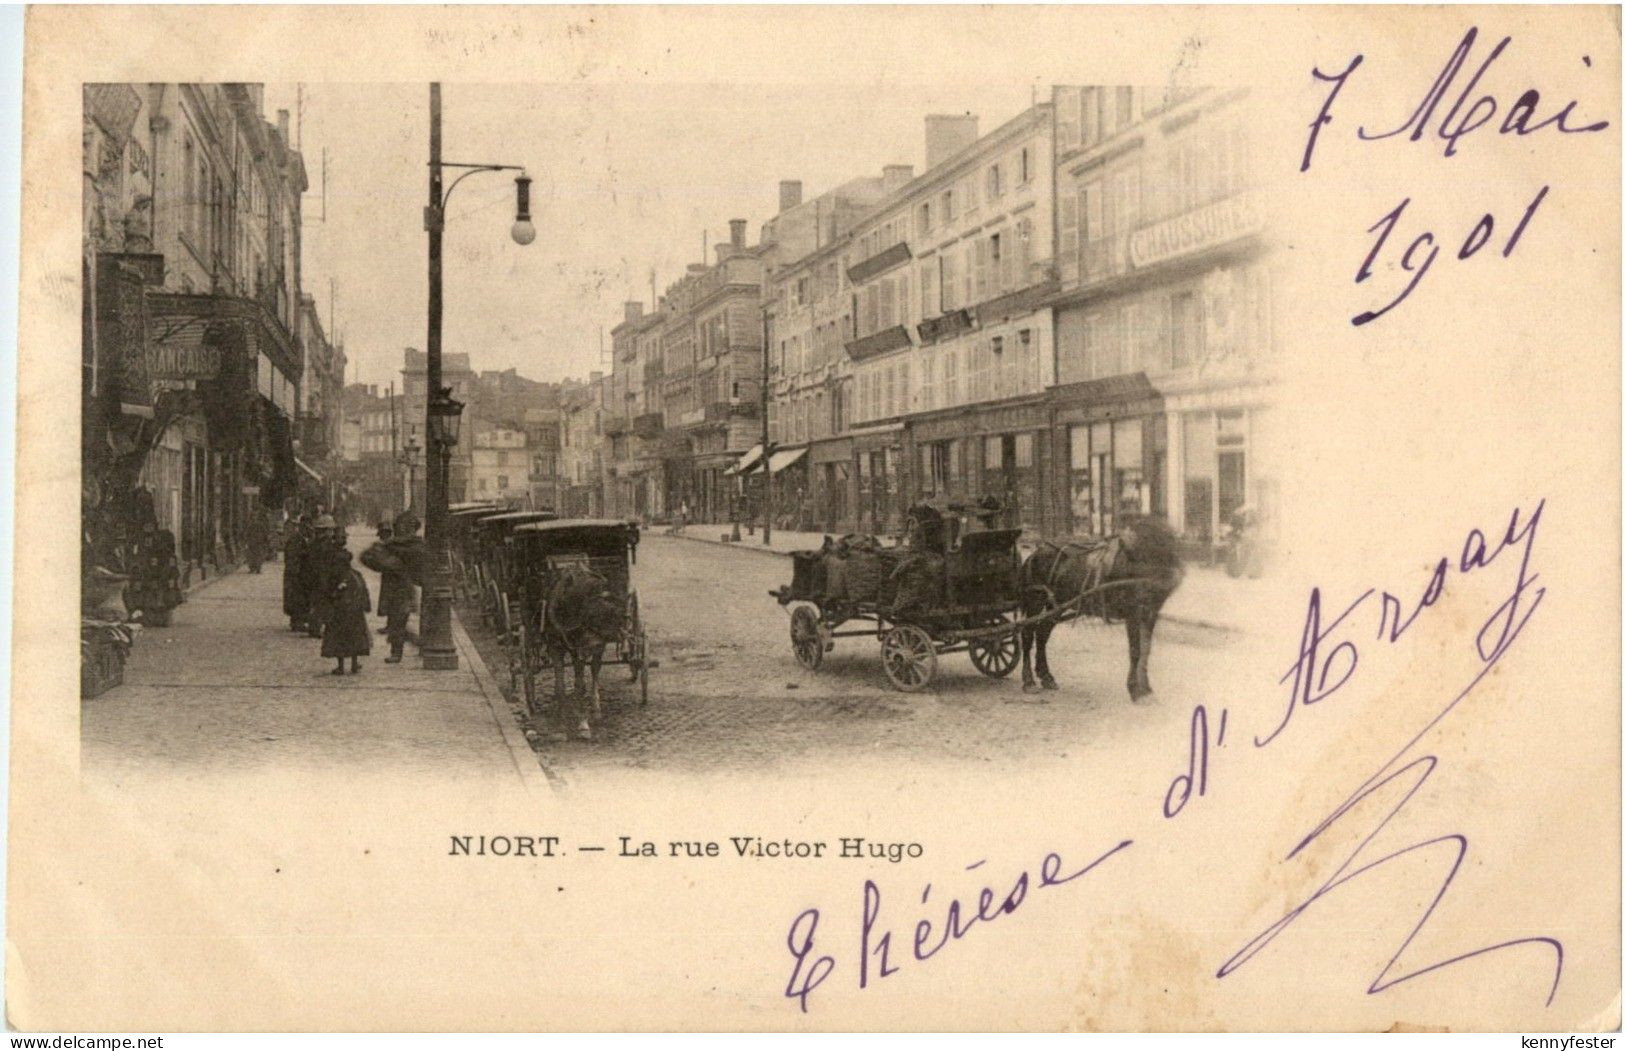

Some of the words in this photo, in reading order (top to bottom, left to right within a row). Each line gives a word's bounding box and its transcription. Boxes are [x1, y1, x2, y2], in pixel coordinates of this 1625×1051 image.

[1301, 54, 1363, 172] 7
[1355, 27, 1608, 156] Mai
[1352, 186, 1548, 326] 1901
[448, 836, 566, 857] NIORT.
[618, 836, 657, 857] La
[668, 841, 720, 857] rue
[731, 838, 826, 857] Victor
[840, 839, 922, 862] Hugo
